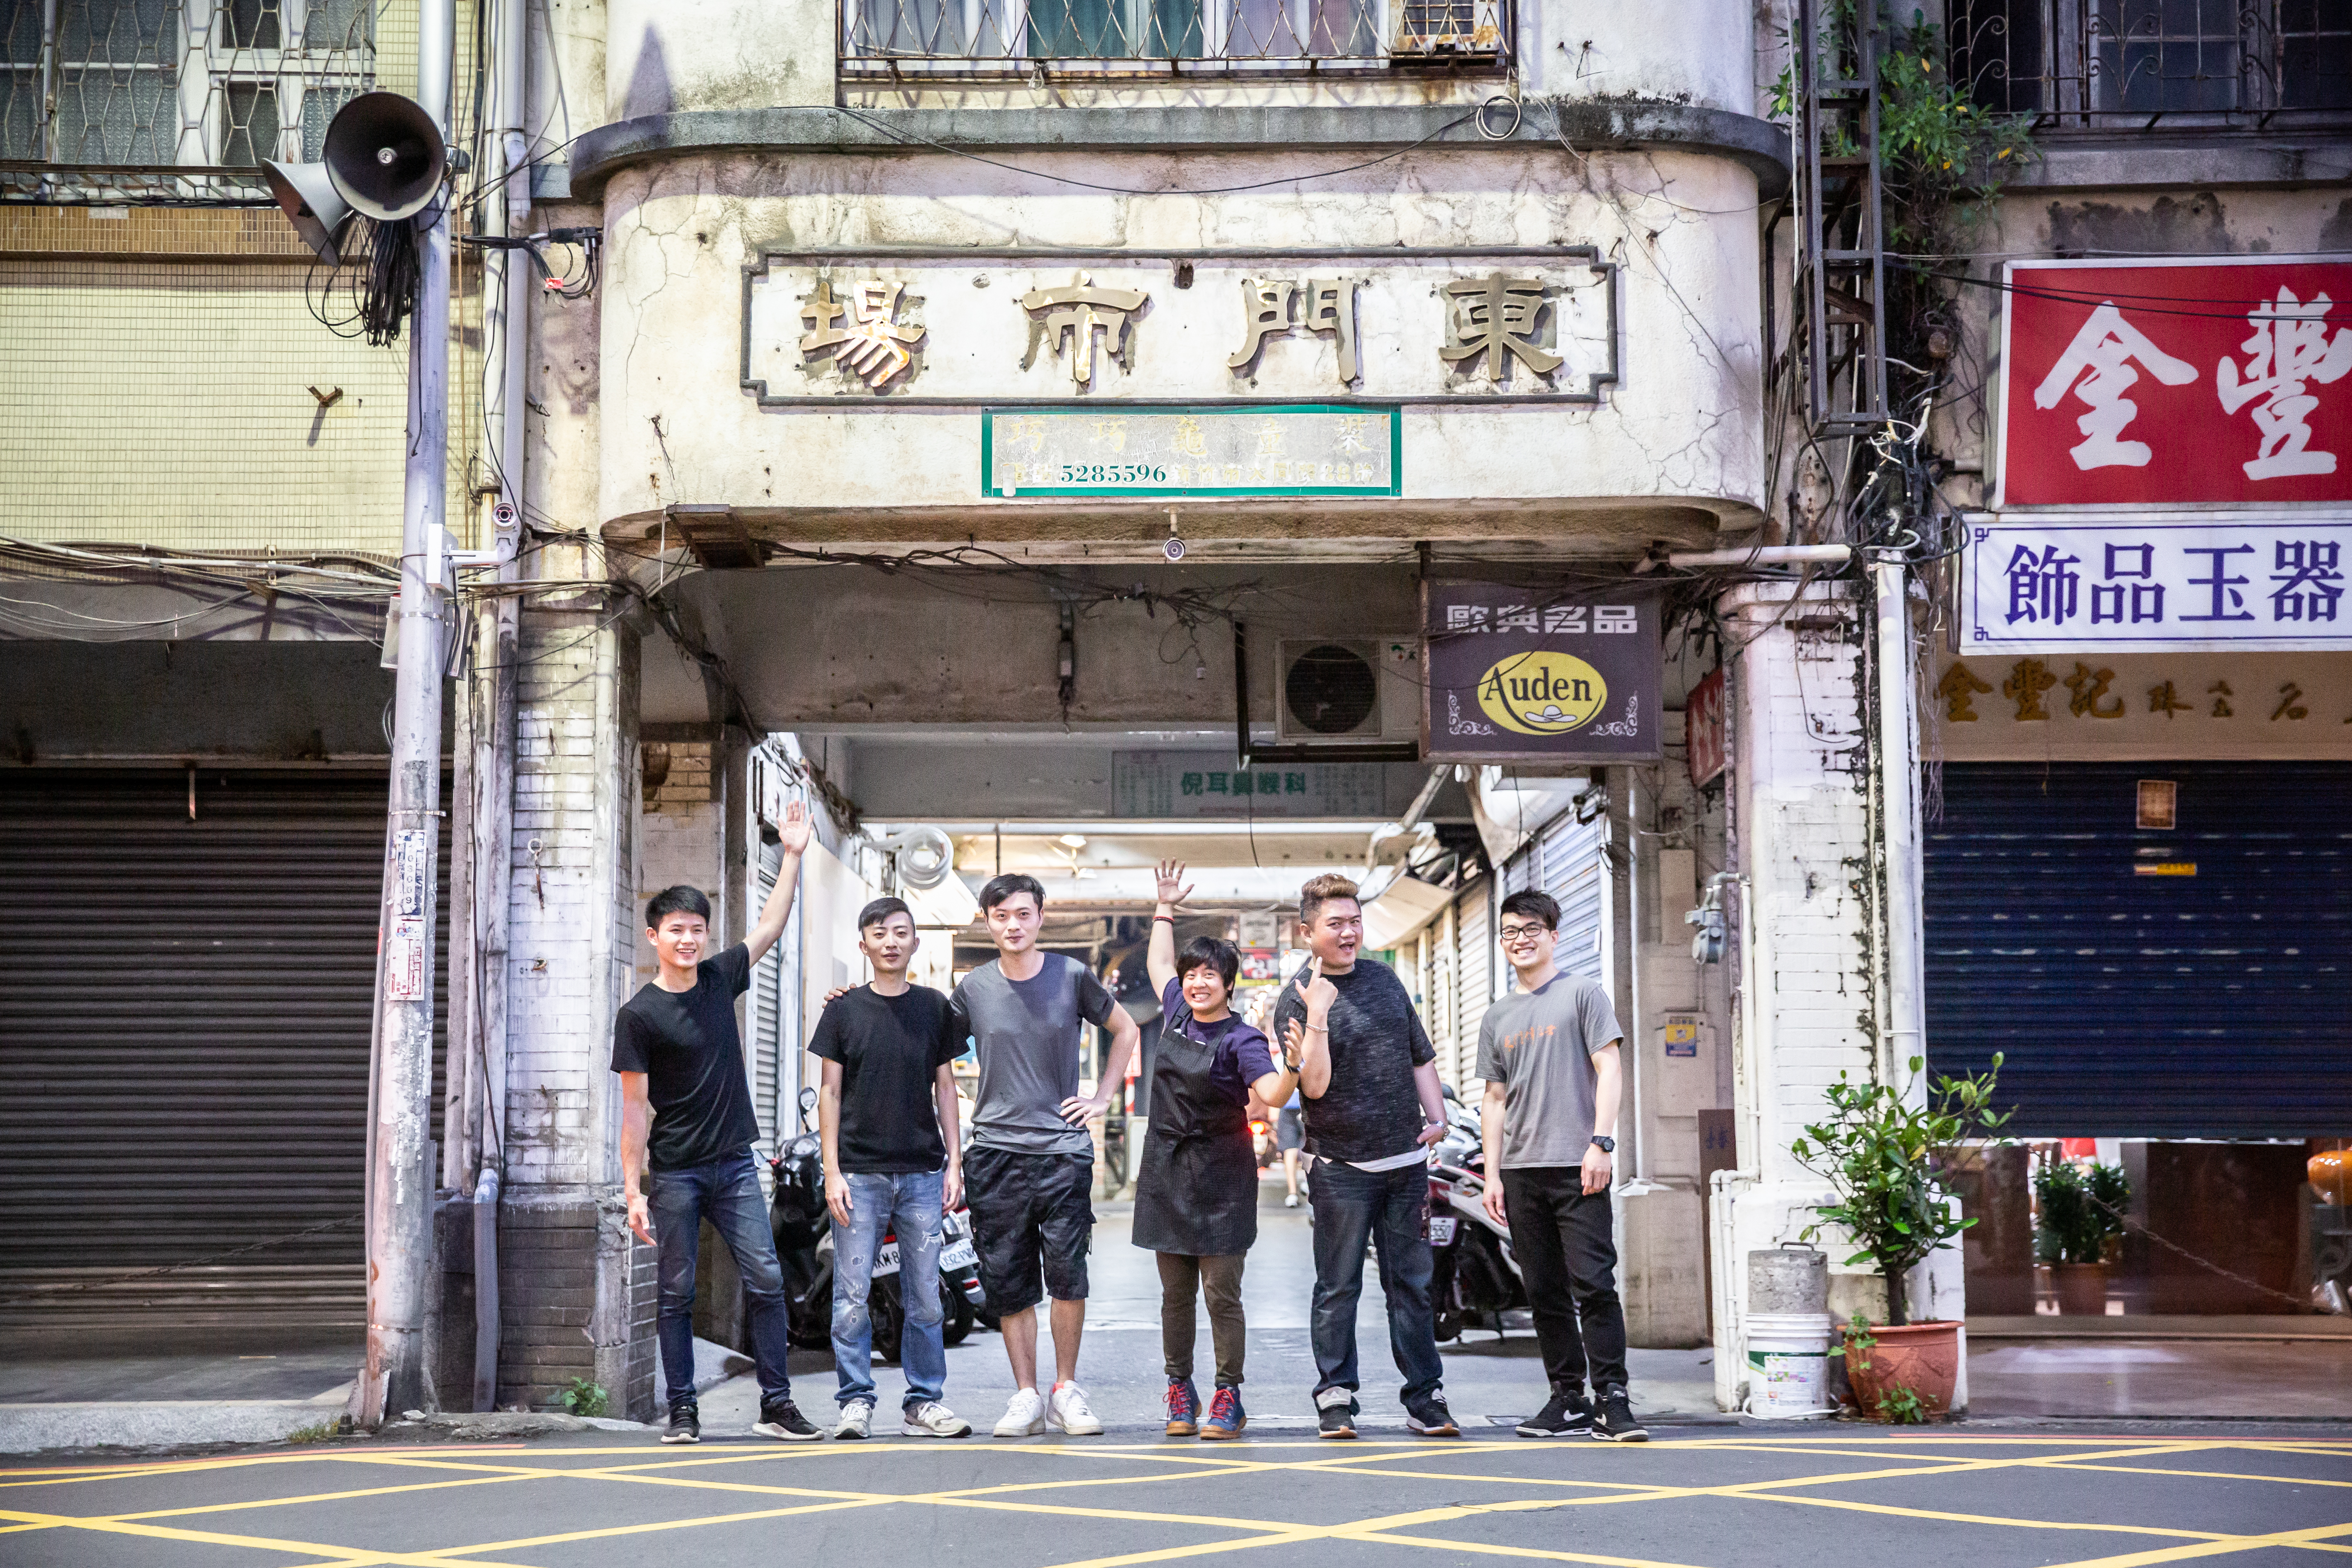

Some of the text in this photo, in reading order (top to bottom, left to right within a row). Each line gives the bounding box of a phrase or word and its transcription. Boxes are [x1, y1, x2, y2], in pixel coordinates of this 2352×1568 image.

[2034, 285, 2352, 481] 金豐
[1061, 464, 1166, 482] 5285596
[2003, 540, 2345, 625] 飾品玉器
